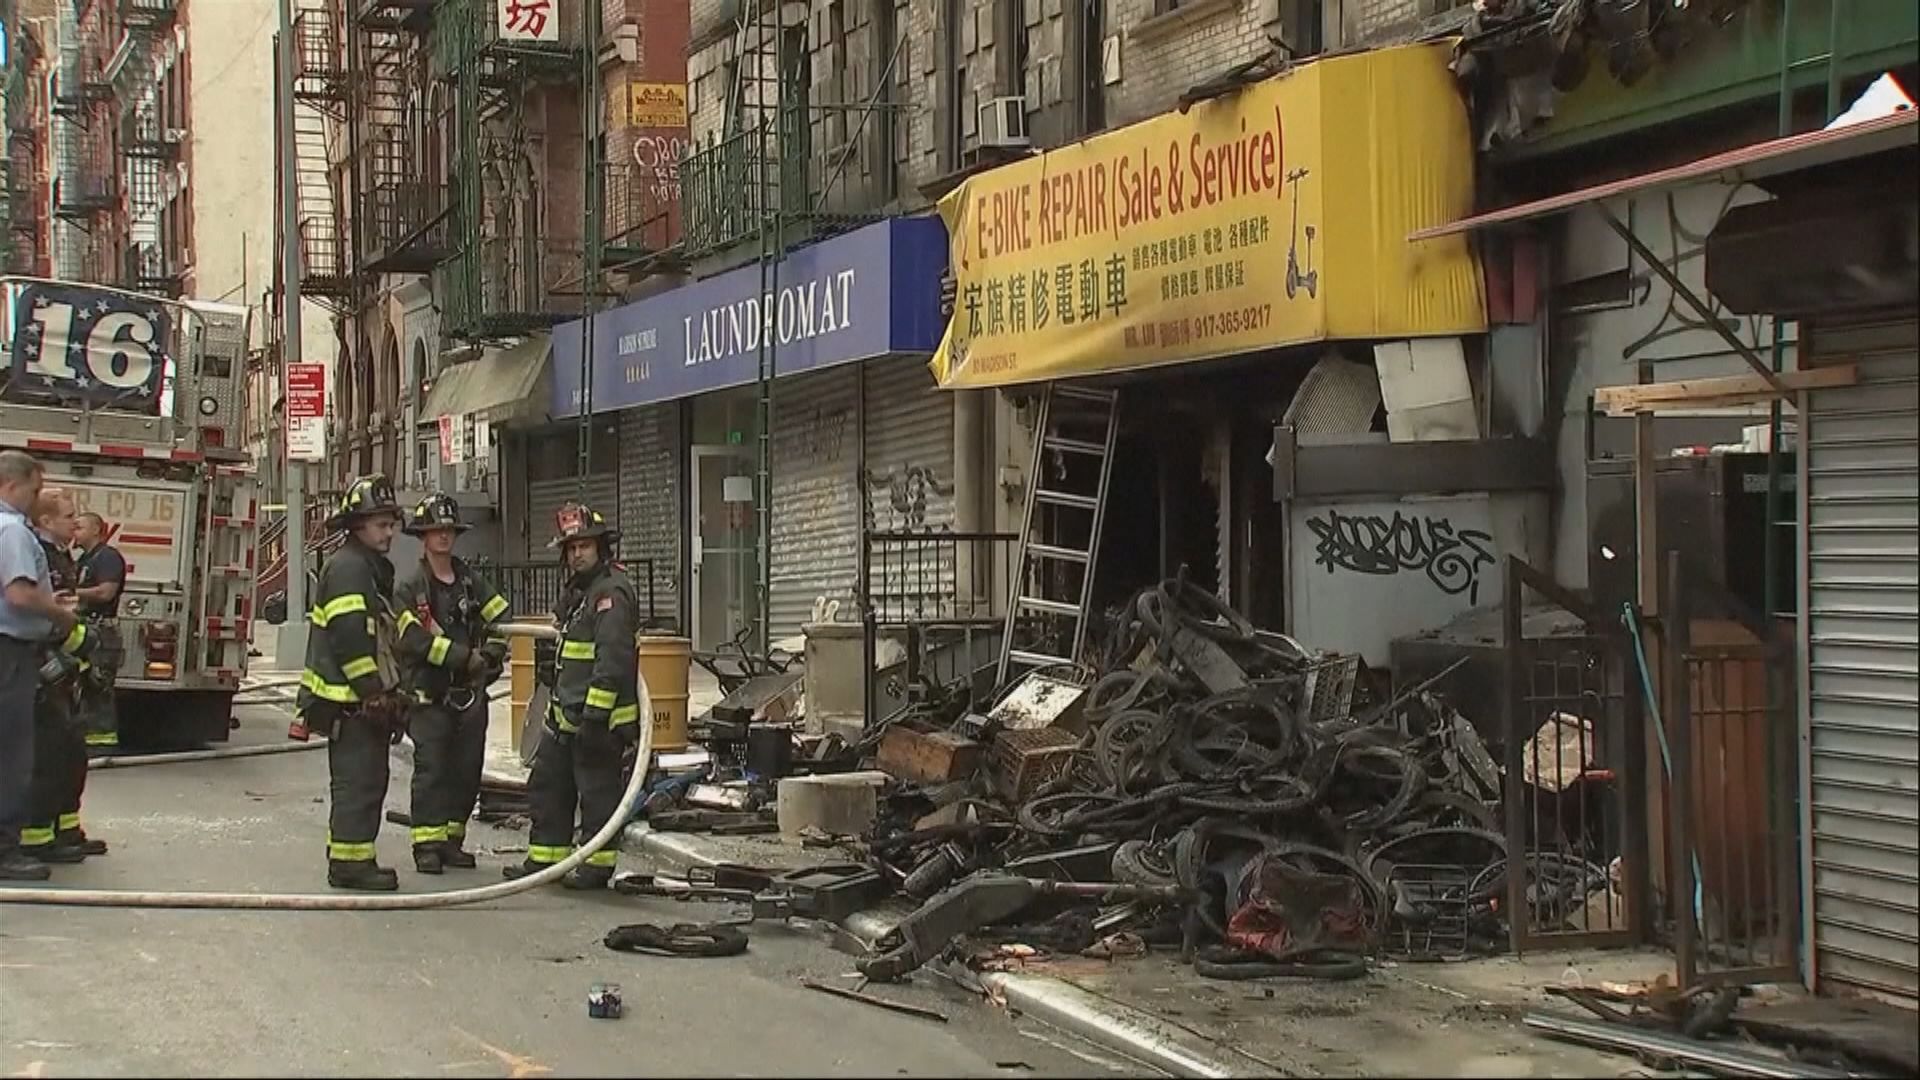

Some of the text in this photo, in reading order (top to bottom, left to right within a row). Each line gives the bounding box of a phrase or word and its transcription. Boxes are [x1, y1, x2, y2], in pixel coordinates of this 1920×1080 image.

[977, 183, 1031, 260] E-BIKE
[1038, 162, 1108, 245] REPAIR
[1111, 145, 1163, 239] (Sale
[1168, 140, 1186, 214] &
[1189, 105, 1285, 206] Service)
[25, 302, 158, 389] 16
[684, 268, 856, 366] LAUNDROMAT
[1194, 303, 1272, 339] 917-365-9217
[149, 494, 174, 521] 16
